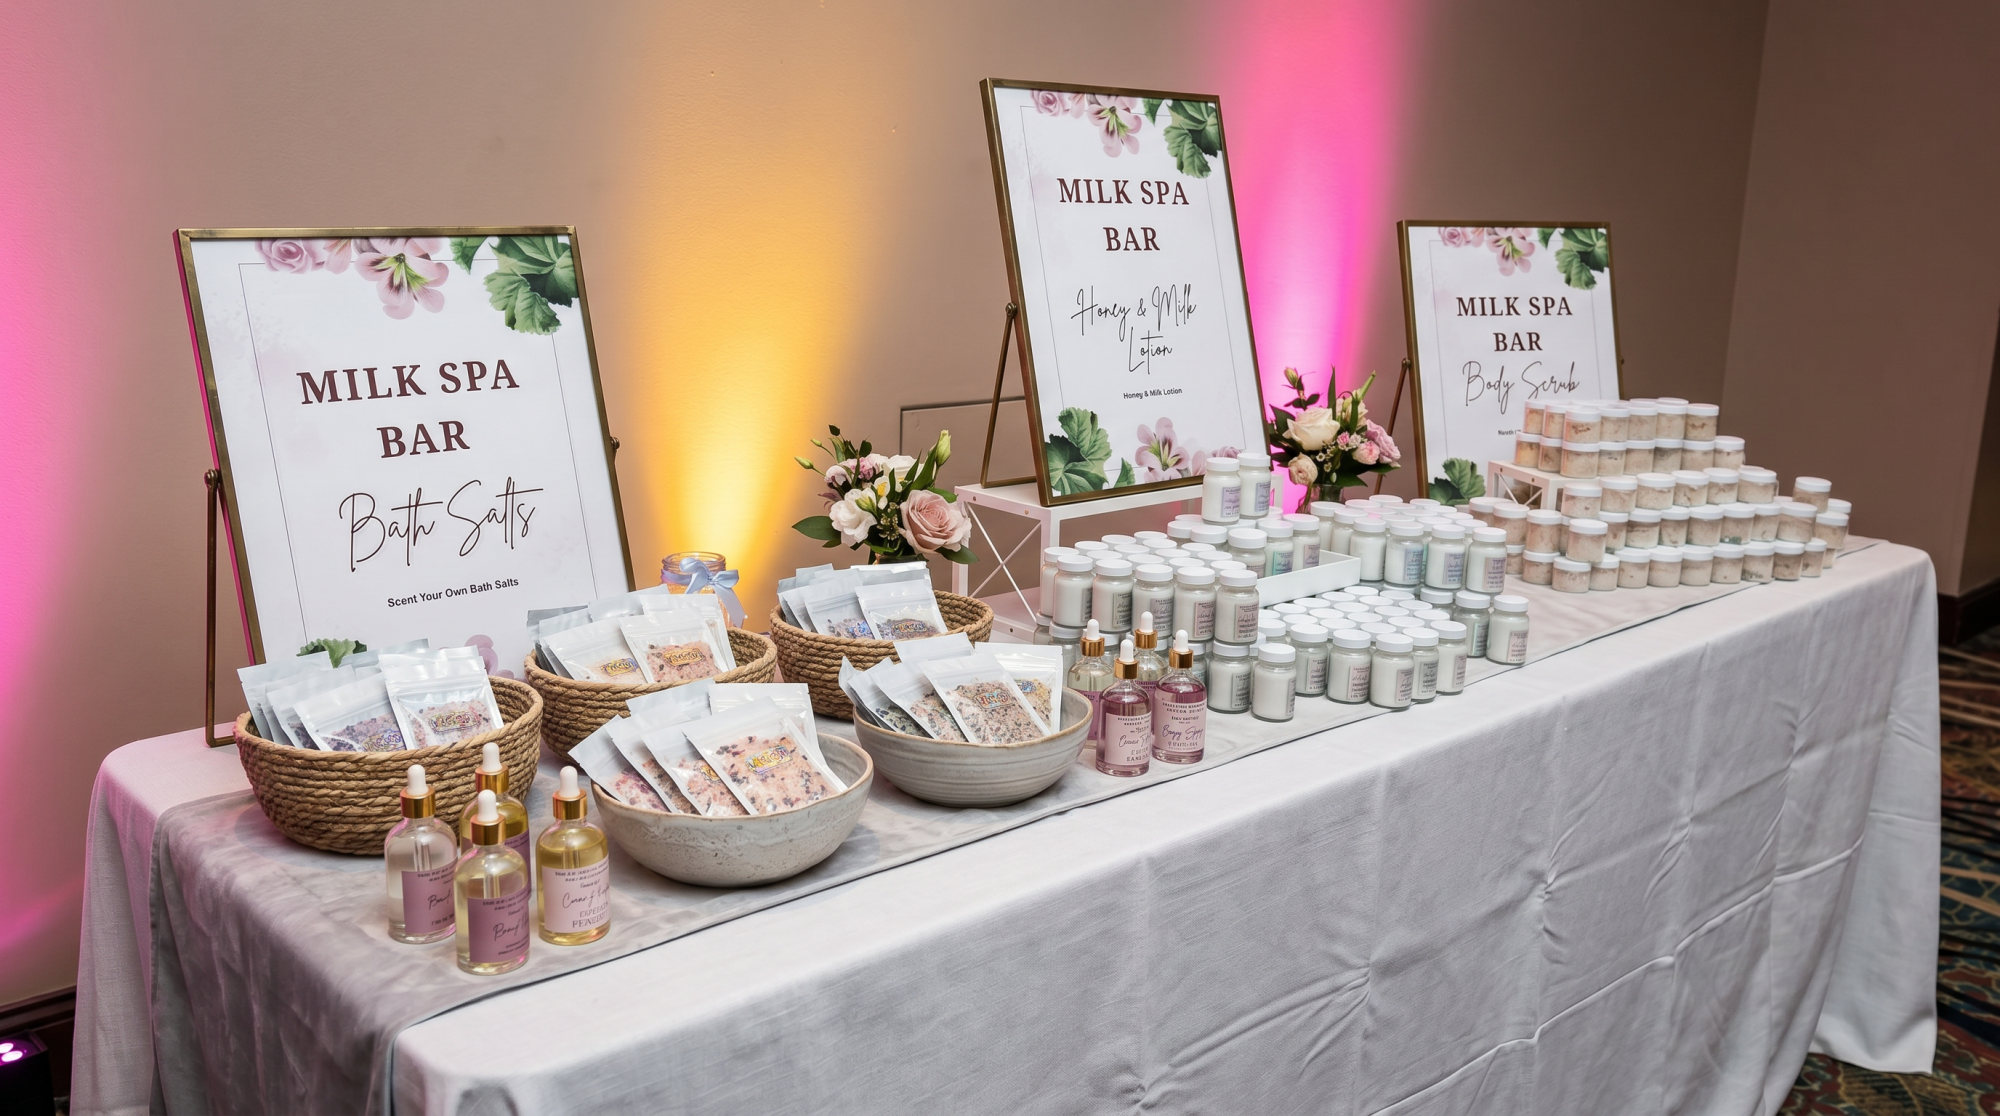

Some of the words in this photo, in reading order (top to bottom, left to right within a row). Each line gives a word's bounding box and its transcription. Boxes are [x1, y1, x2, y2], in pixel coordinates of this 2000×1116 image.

[1057, 178, 1132, 203] MILK
[1141, 181, 1189, 205] SPA
[1103, 227, 1160, 251] BAR
[1071, 286, 1131, 342] Honey
[1137, 297, 1147, 317] &
[1152, 283, 1197, 331] Milk
[1456, 297, 1520, 316] MILK
[1529, 297, 1572, 315] SPA
[1128, 327, 1173, 374] Lotion
[1493, 332, 1542, 351] BAR
[296, 365, 426, 404] MILK
[439, 360, 519, 393] SPA
[1123, 392, 1144, 400] Honey
[1144, 390, 1149, 398] &
[1149, 388, 1163, 397] Milk
[1163, 387, 1183, 396] Lotion
[1462, 361, 1516, 415] Body
[1521, 361, 1580, 399] Scrub
[377, 421, 470, 458] BAR
[339, 487, 443, 572] Bath
[447, 477, 544, 557] Salts
[387, 595, 418, 608] Scent
[419, 590, 443, 602] Your
[444, 586, 468, 597] Own
[469, 581, 493, 594] Bath
[494, 576, 519, 590] Salts
